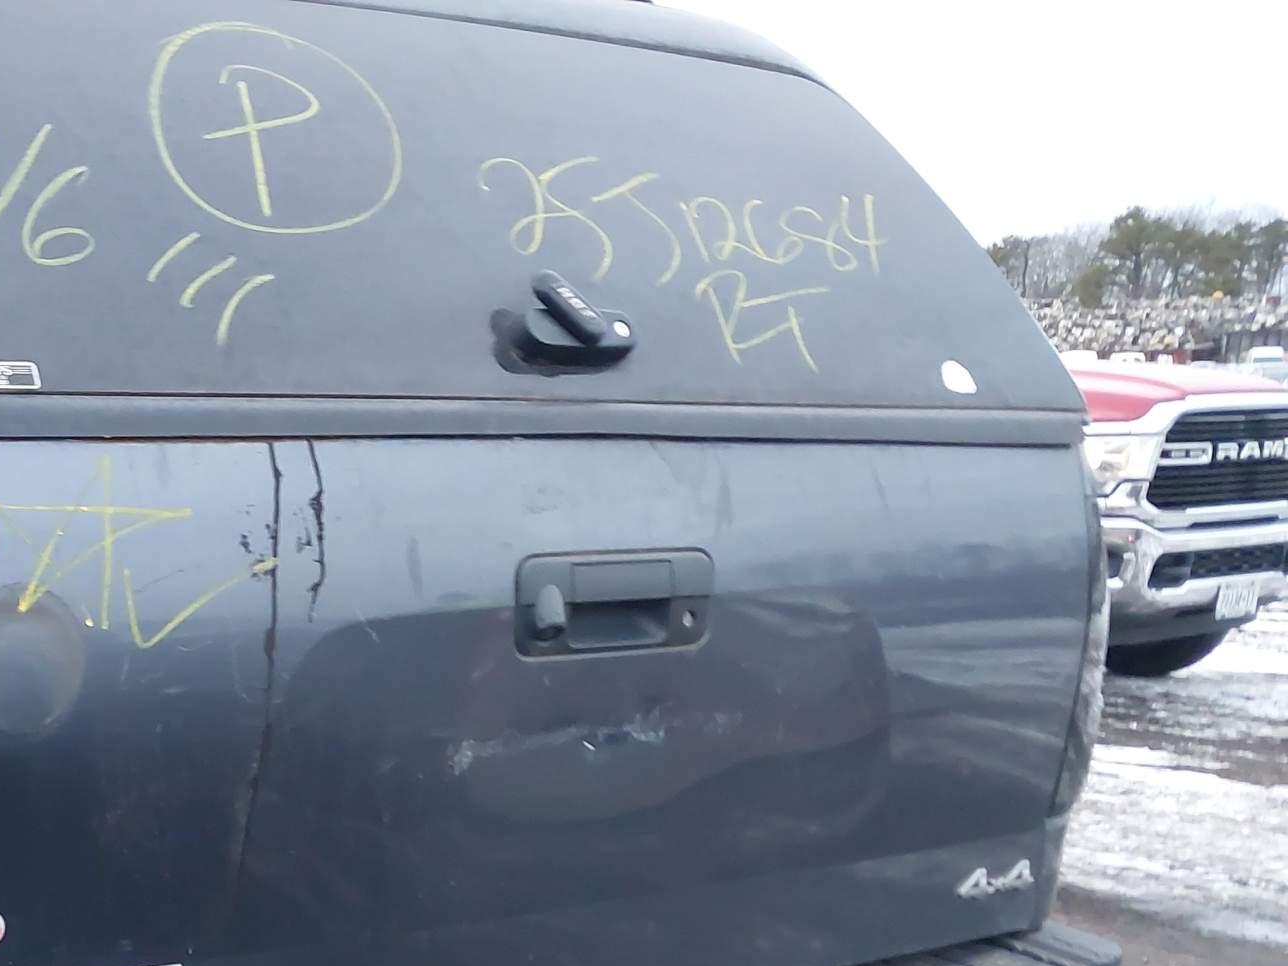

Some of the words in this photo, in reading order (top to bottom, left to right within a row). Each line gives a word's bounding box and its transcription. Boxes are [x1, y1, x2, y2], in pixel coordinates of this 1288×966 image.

[202, 64, 320, 217] P
[1215, 440, 1284, 462] RAM
[956, 859, 1035, 897] 4x4
